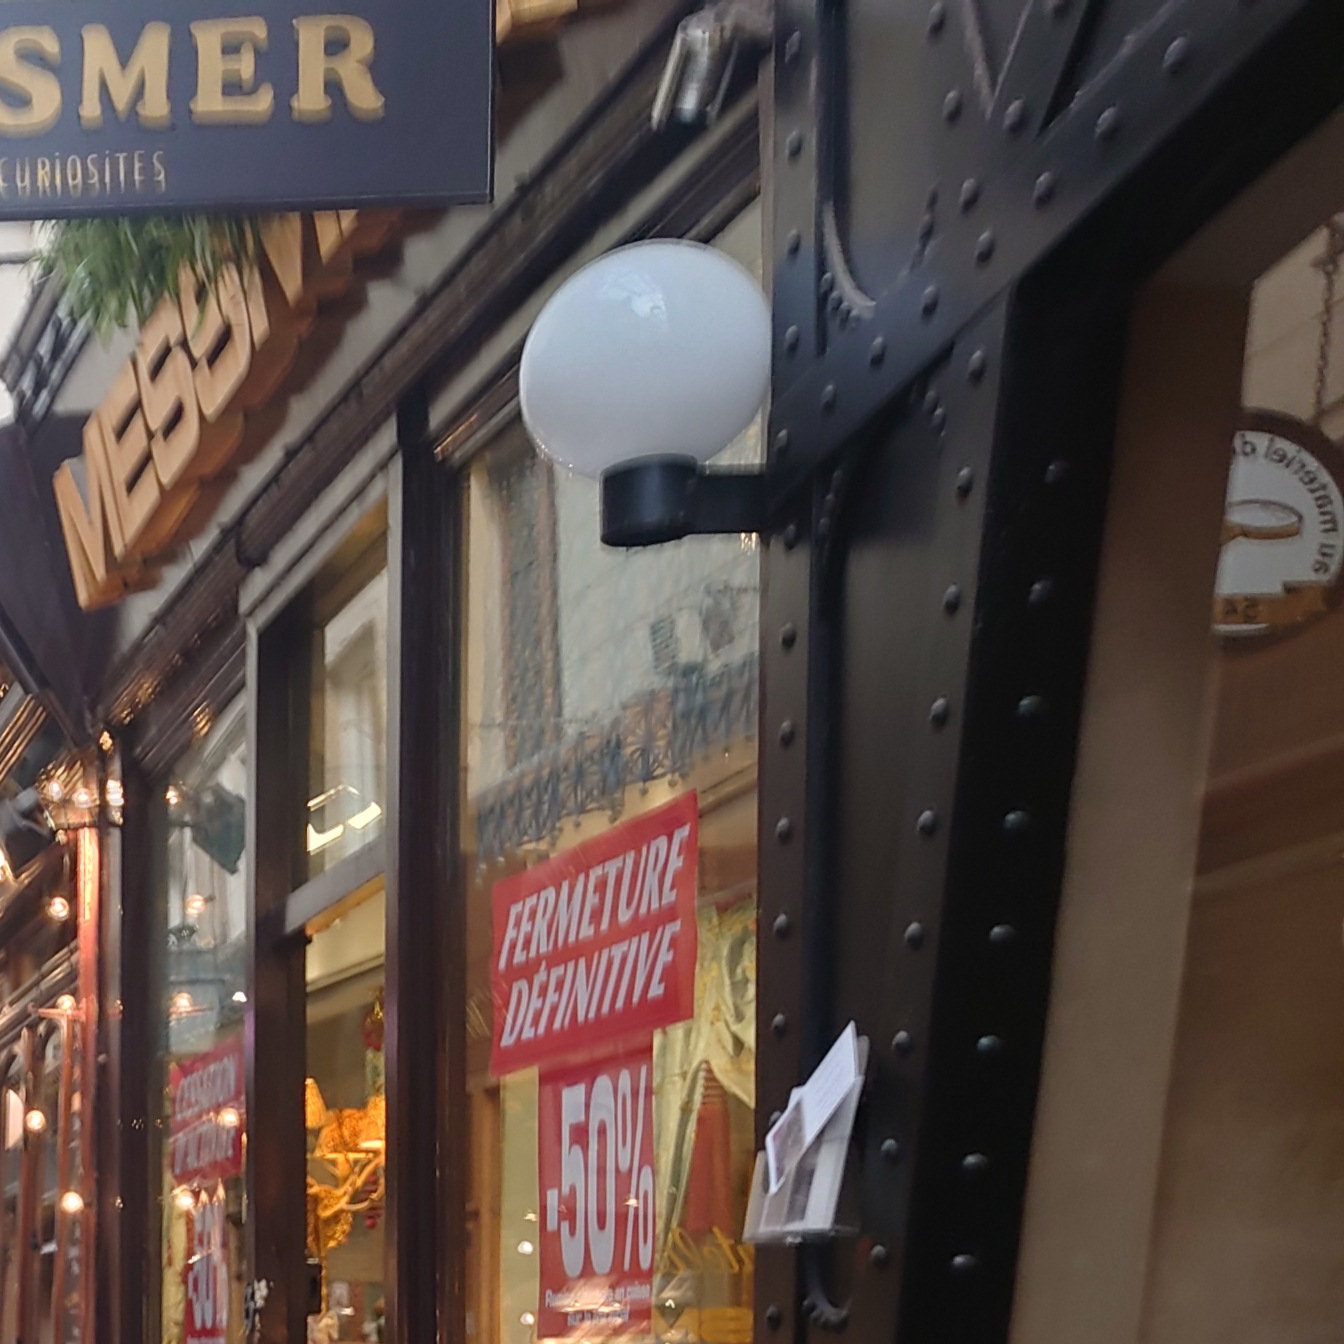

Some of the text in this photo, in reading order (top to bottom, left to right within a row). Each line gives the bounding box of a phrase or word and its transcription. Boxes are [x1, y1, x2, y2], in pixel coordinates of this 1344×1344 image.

[498, 822, 690, 970] FERMETURE
[499, 919, 681, 1048] DÉFINITIVE
[546, 1065, 653, 1278] -50%
